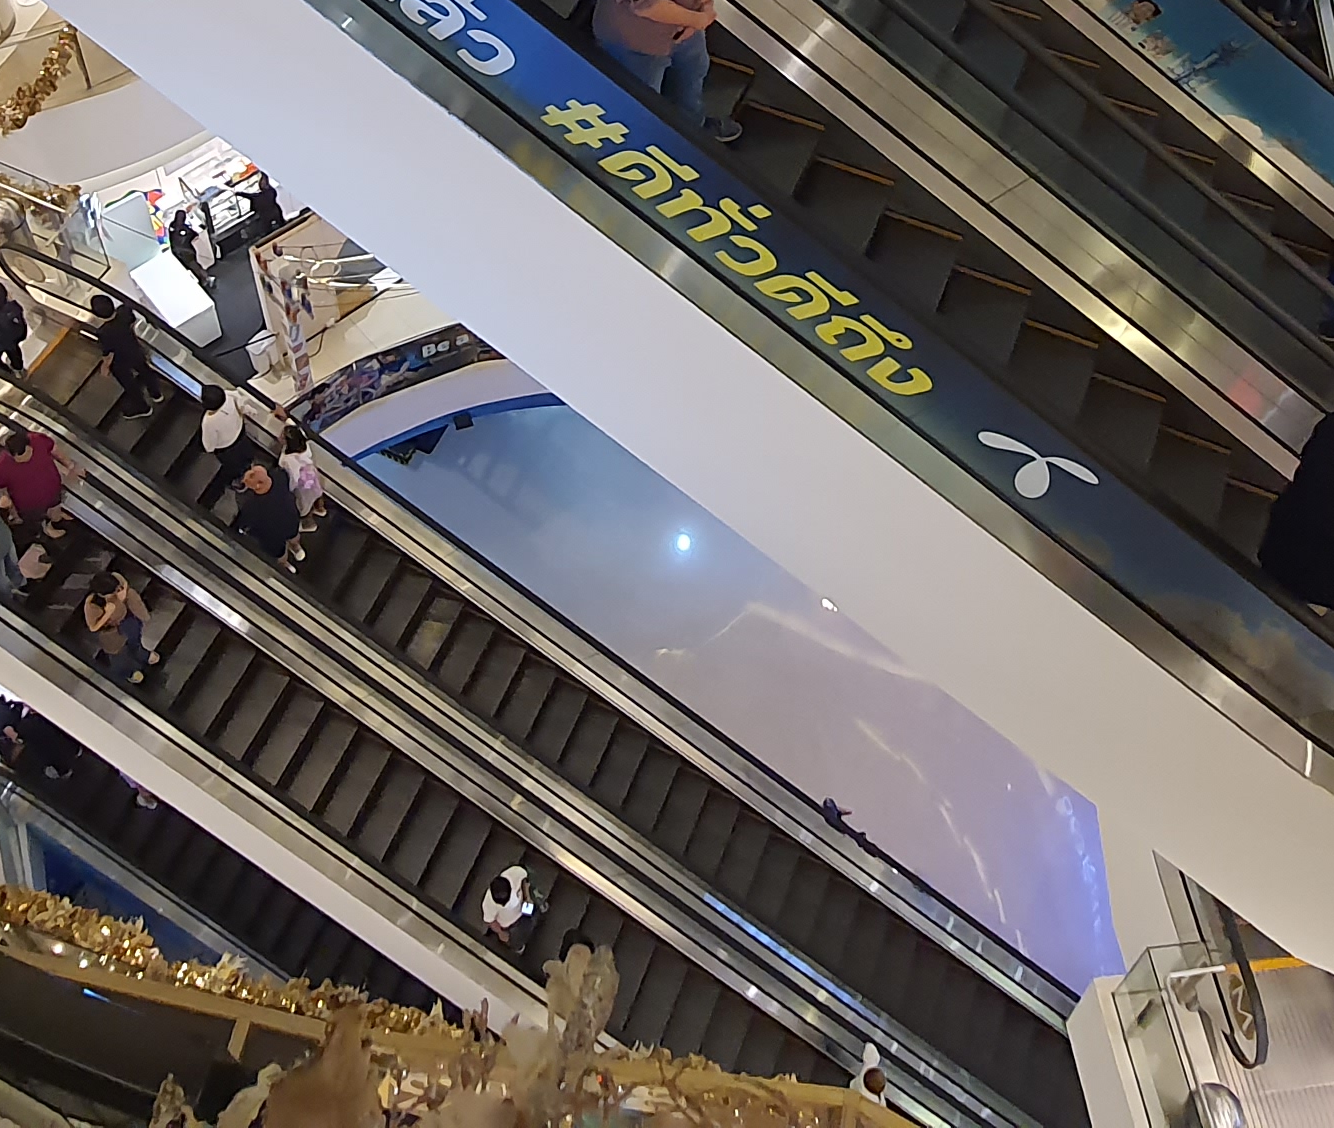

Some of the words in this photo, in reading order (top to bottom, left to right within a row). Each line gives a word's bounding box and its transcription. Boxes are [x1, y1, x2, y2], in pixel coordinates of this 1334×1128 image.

[539, 98, 934, 396] #ดีทั่วดีถึง
